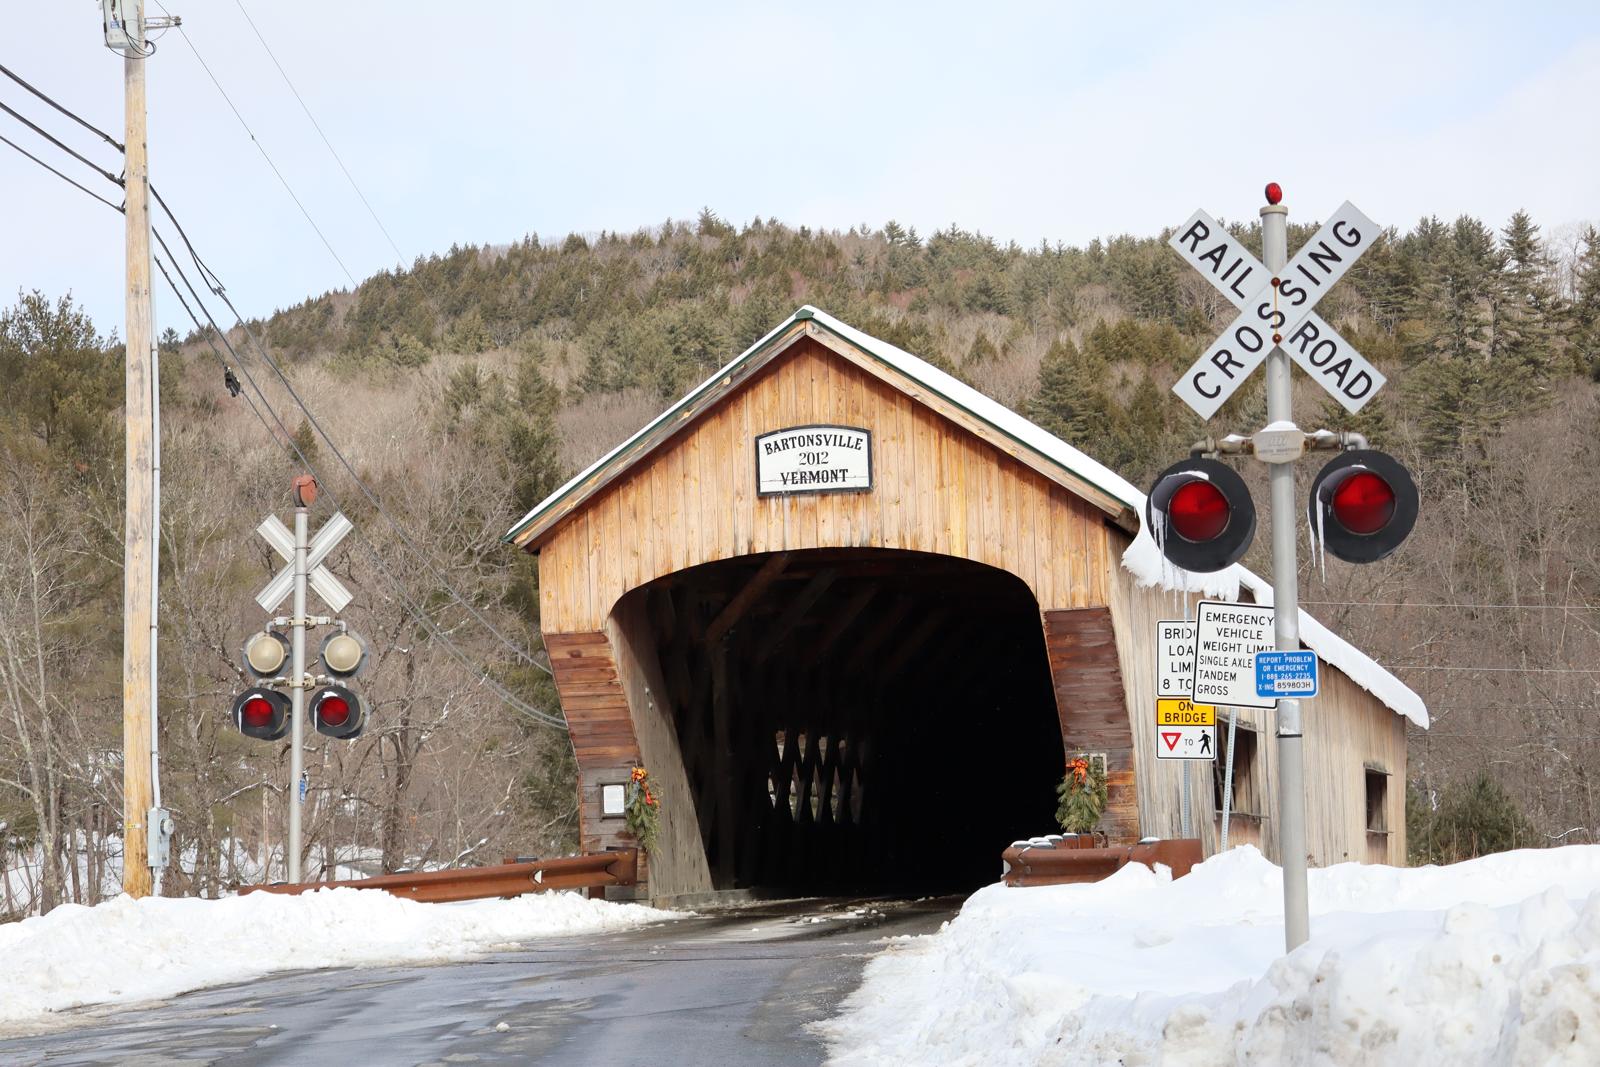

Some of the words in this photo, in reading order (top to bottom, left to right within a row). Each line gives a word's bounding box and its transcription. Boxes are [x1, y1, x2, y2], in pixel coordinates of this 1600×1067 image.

[1179, 219, 1253, 299] RAIL
[1289, 320, 1373, 400] ROAD
[1192, 220, 1362, 399] CROSSING
[764, 434, 863, 455] BARTONSVILLE
[799, 451, 829, 466] 2012
[780, 468, 849, 485] VERMONT
[1205, 612, 1275, 626] EMERGENCY
[1164, 628, 1196, 639] BRID
[1216, 627, 1263, 640] VEHICLE
[1203, 641, 1242, 653] WEIGHT
[1199, 655, 1229, 667] SINGLE
[1231, 658, 1253, 669] AXLE
[1258, 656, 1282, 664] REPORT
[1284, 655, 1312, 663] PROBLEM
[1273, 664, 1309, 672] EMERGENCY
[1198, 669, 1237, 681] TANDEM
[1162, 678, 1170, 690] 8
[1197, 684, 1229, 696] GROSS
[1178, 701, 1194, 711] ON
[1165, 712, 1207, 723] BRIDGE
[1184, 738, 1194, 746] TO
